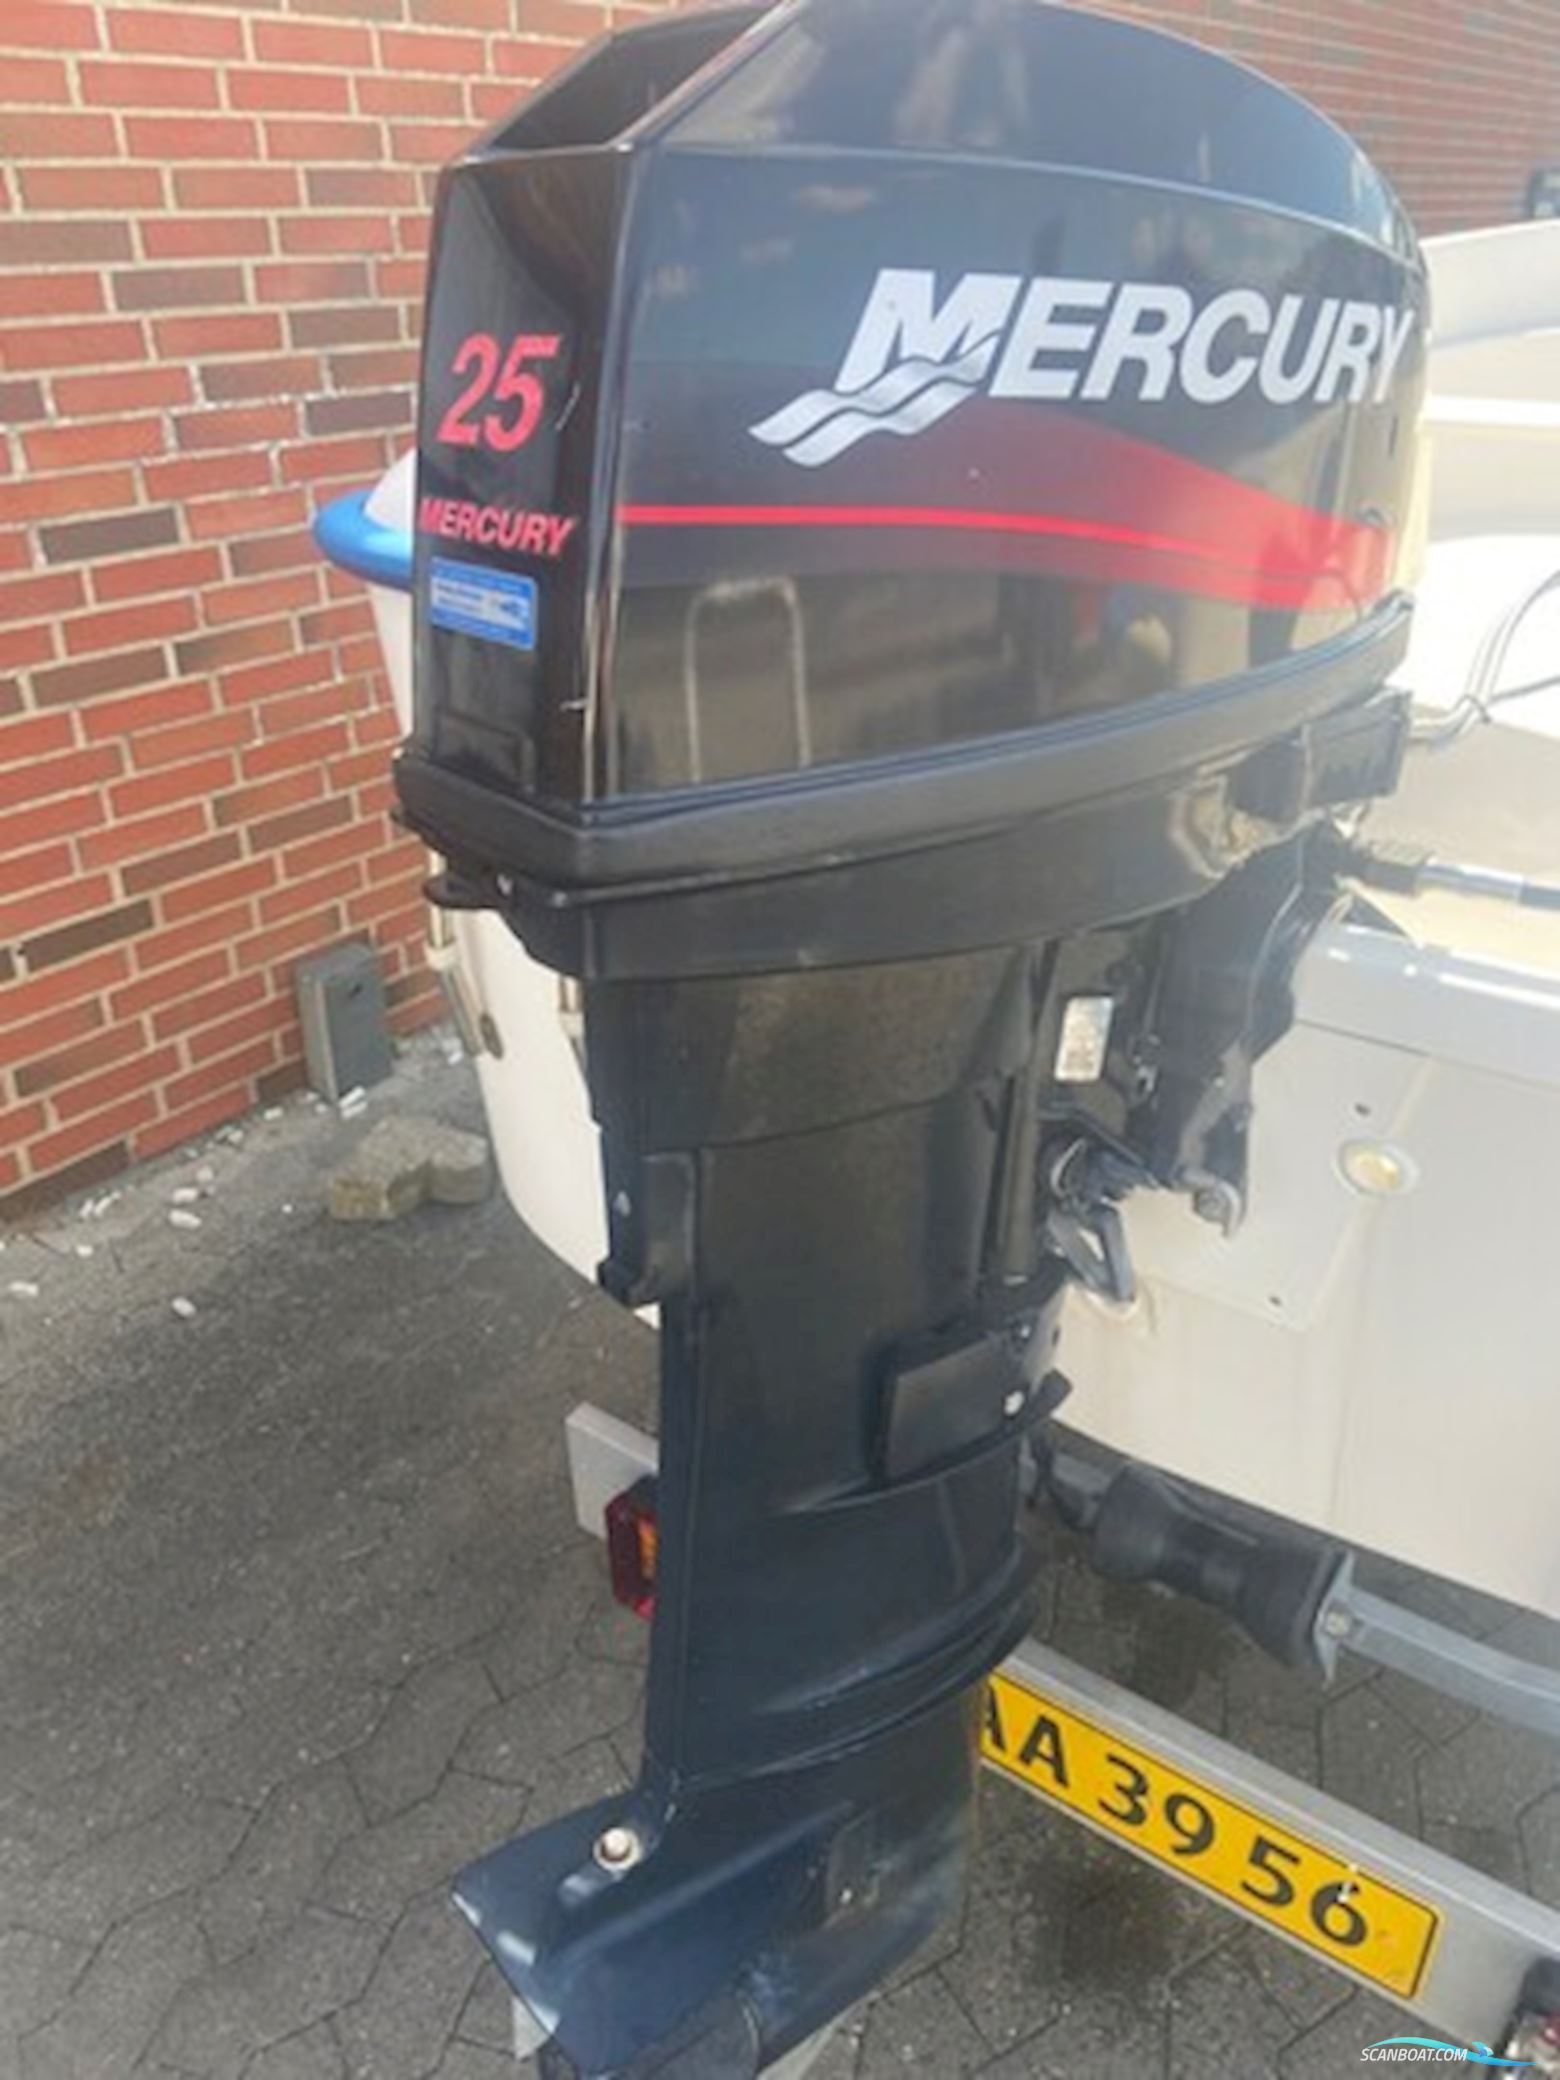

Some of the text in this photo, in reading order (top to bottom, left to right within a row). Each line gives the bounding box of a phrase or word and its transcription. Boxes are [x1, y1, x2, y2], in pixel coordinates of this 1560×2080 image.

[437, 332, 560, 451] 25
[834, 268, 1413, 402] MERCURY
[418, 496, 574, 556] MERCURY
[1097, 1754, 1216, 1856] 39
[1240, 1836, 1369, 1948] 56
